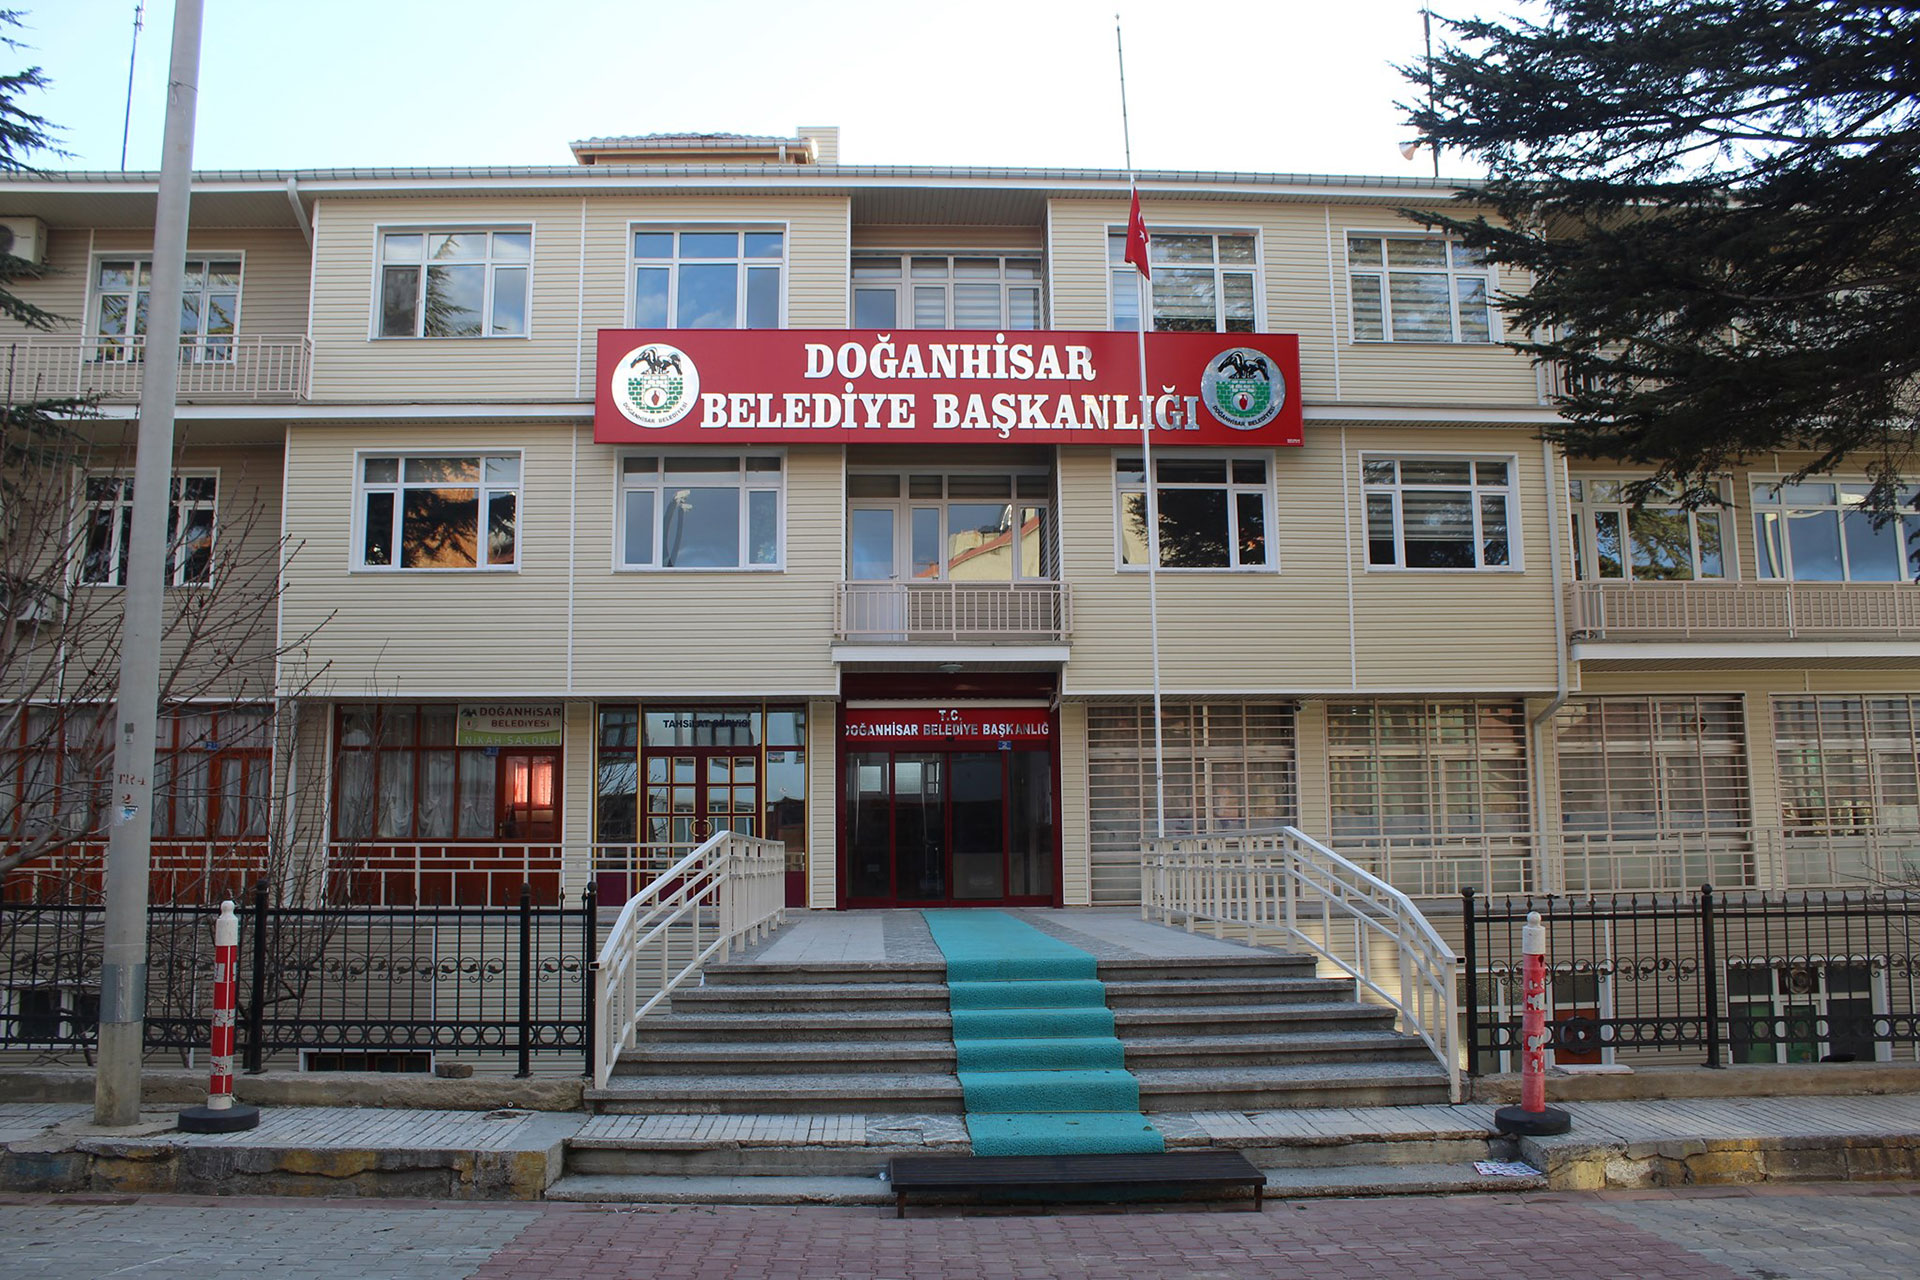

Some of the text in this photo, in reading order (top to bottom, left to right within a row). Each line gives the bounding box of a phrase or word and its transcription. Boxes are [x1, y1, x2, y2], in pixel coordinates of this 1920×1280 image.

[803, 333, 1096, 381] DOĞANHİSAR
[699, 381, 1200, 439] BELEDİYE BAŞKANLIĞI
[938, 709, 963, 721] T.C.
[923, 721, 978, 736] BELEDİYE
[982, 721, 1049, 738] BAŞKANLIĞ
[506, 735, 557, 745] SALONU
